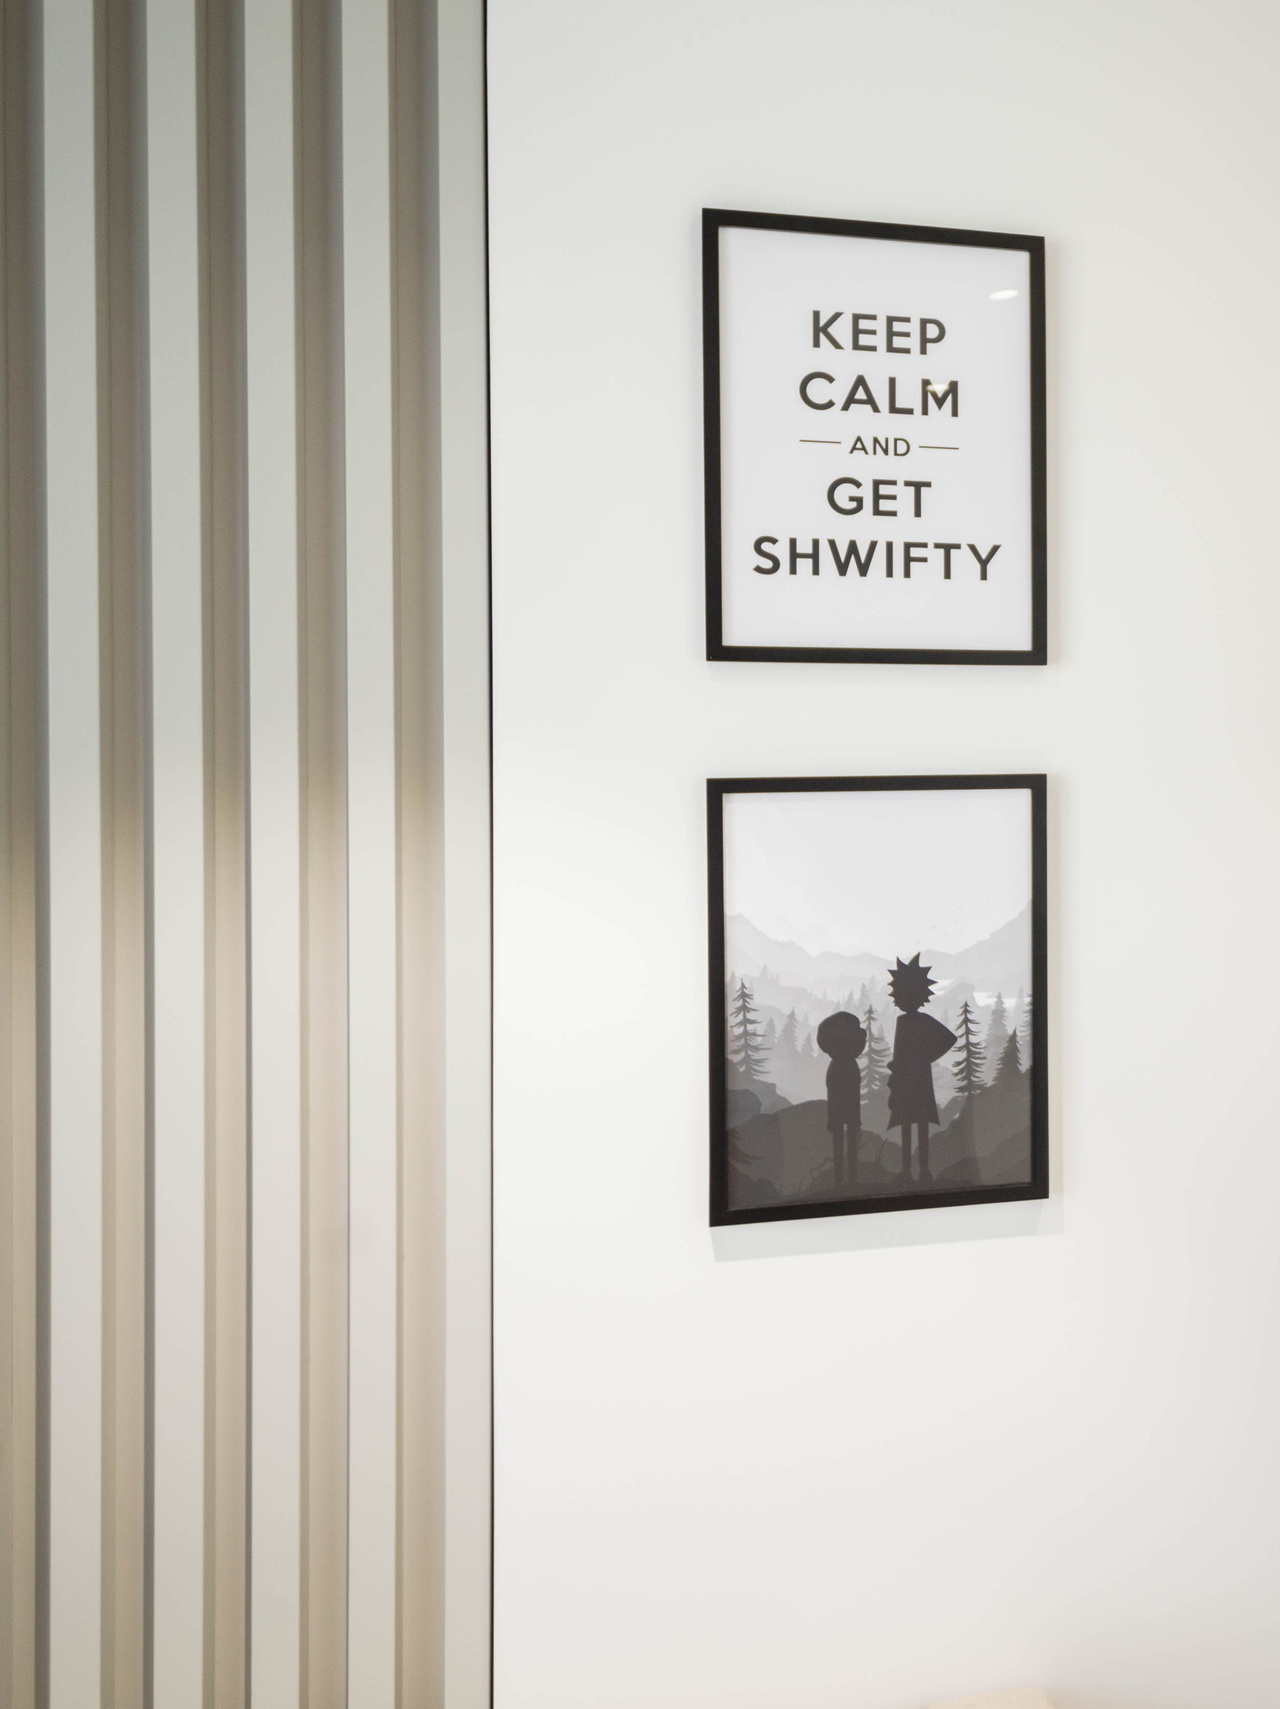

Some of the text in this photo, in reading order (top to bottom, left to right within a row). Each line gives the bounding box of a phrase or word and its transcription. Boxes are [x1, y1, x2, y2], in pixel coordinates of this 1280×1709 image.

[812, 310, 946, 355] KEEP
[798, 371, 959, 418] CALM
[848, 435, 911, 457] AND
[826, 476, 932, 518] GET
[753, 536, 1001, 581] SHWIFTY
